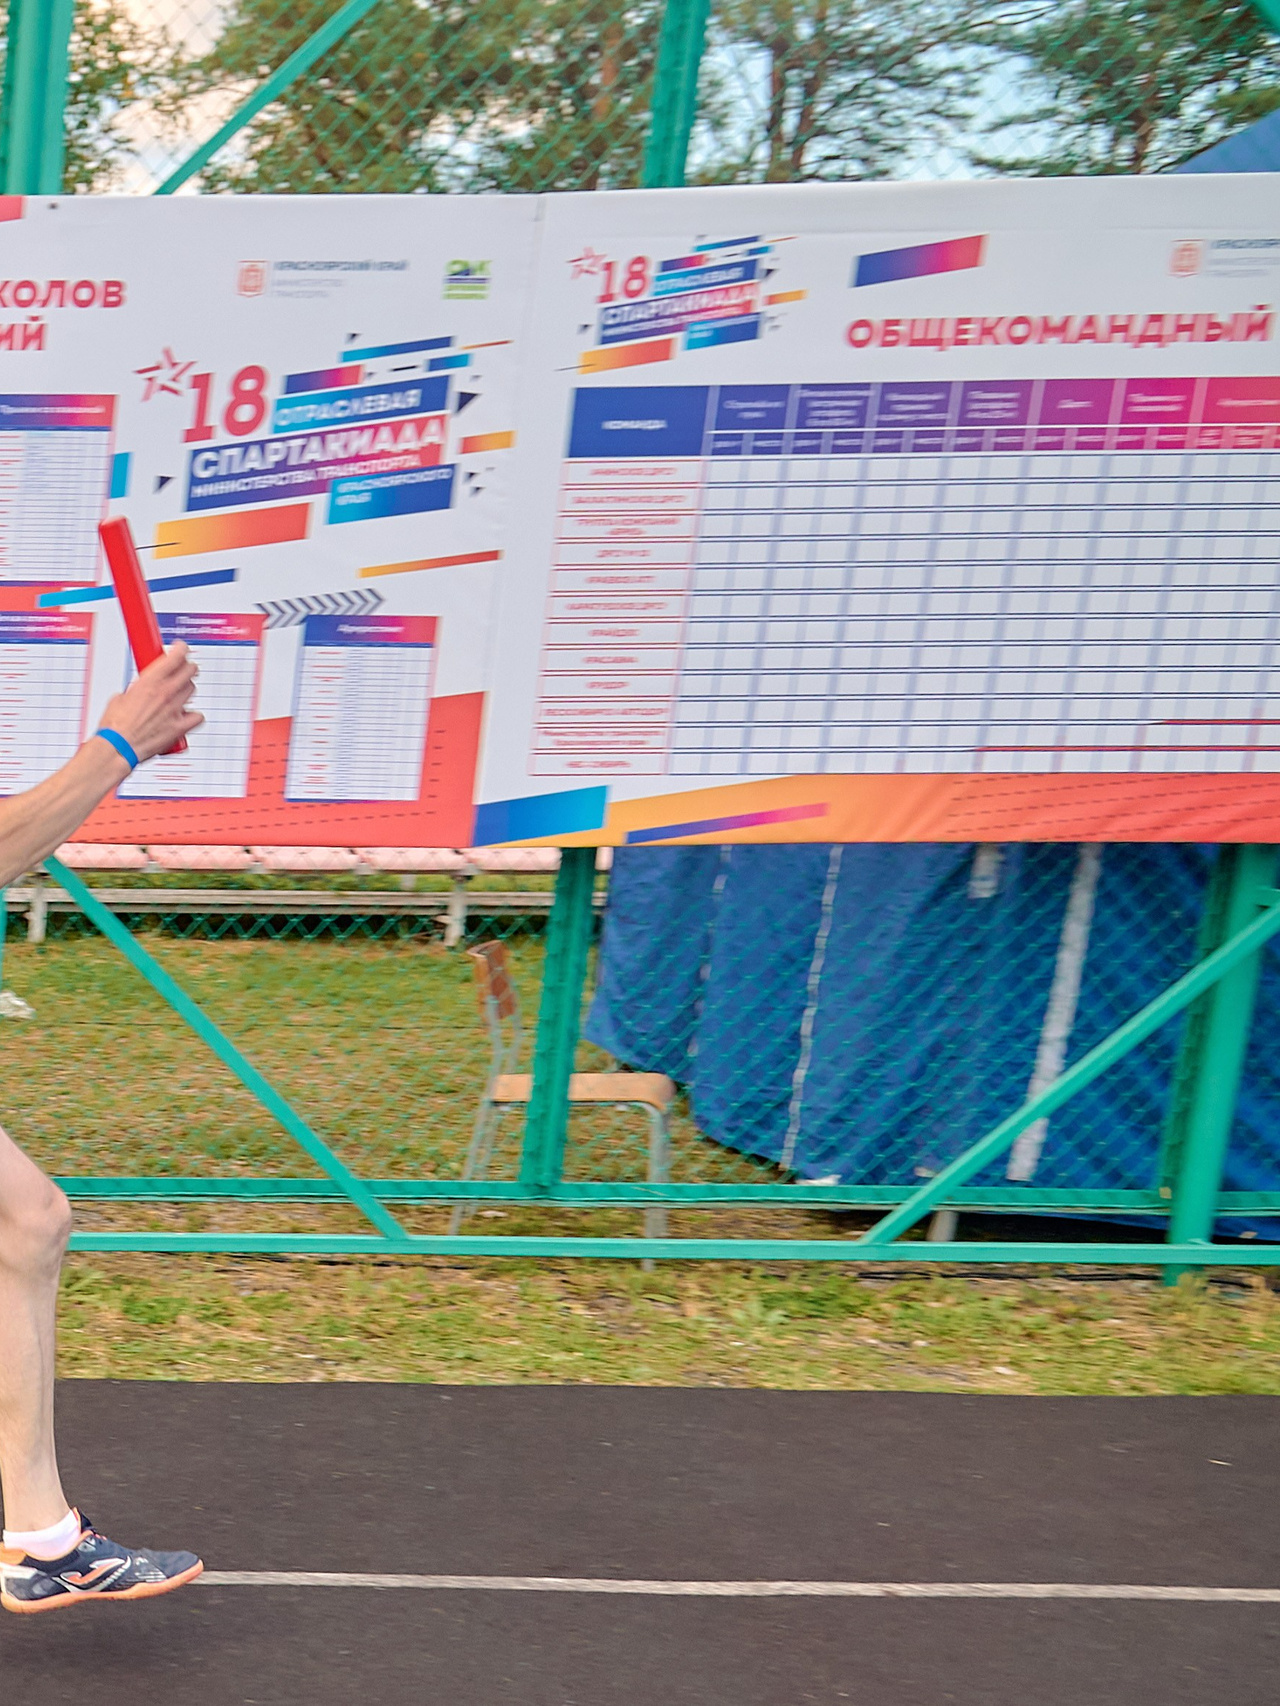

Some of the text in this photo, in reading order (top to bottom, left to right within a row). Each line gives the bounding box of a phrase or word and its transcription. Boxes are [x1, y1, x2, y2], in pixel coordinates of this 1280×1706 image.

[596, 255, 650, 303] 18
[845, 304, 1274, 351] ОБЩЕКОМАНДНЫЙ
[183, 364, 268, 443] 18
[276, 389, 421, 426] ОТРАСЛЕВАЯ
[192, 417, 445, 479] СПАРТАКИАДА
[191, 455, 421, 498] МИНИСТЕРСТВА ТРАНСПОРТА
